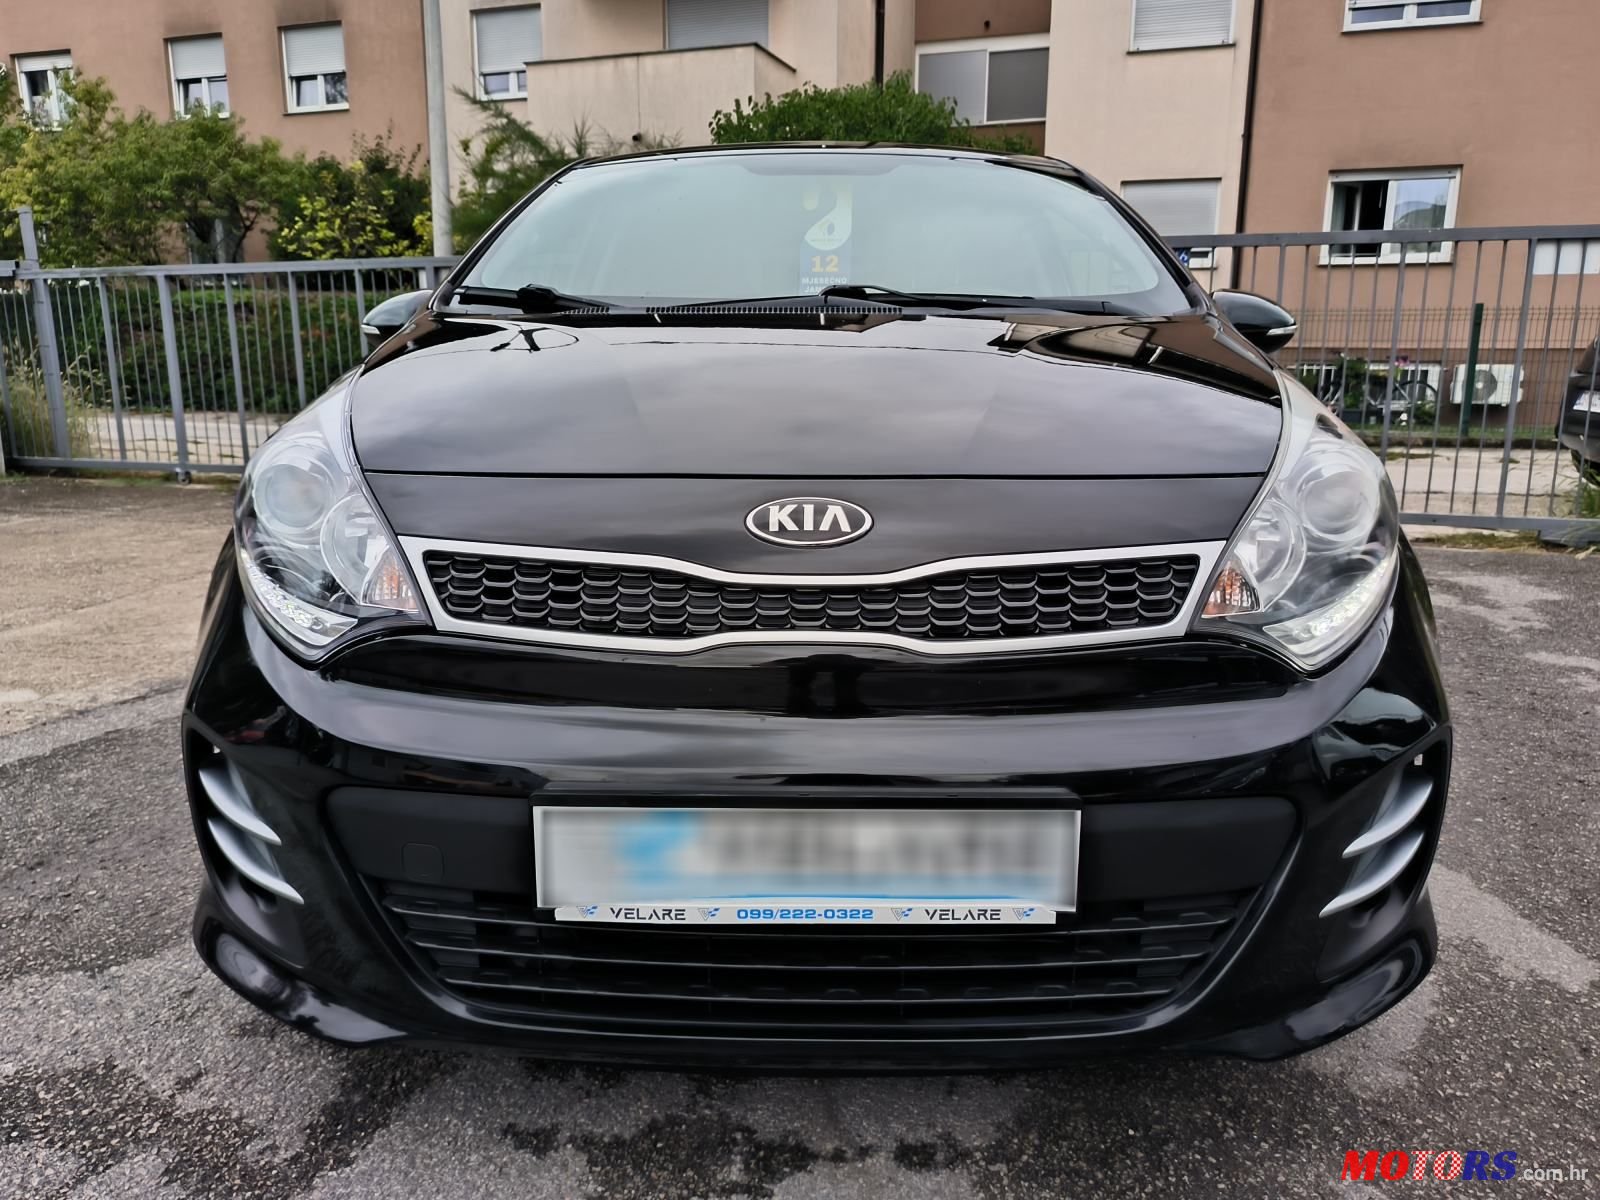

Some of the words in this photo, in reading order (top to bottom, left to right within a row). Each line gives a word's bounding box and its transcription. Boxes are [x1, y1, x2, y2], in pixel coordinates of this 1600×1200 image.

[811, 255, 839, 273] 12
[768, 503, 851, 533] KIA
[610, 907, 687, 920] VELARE
[737, 908, 874, 920] 099/222-0322
[924, 908, 1001, 921] VELARE
